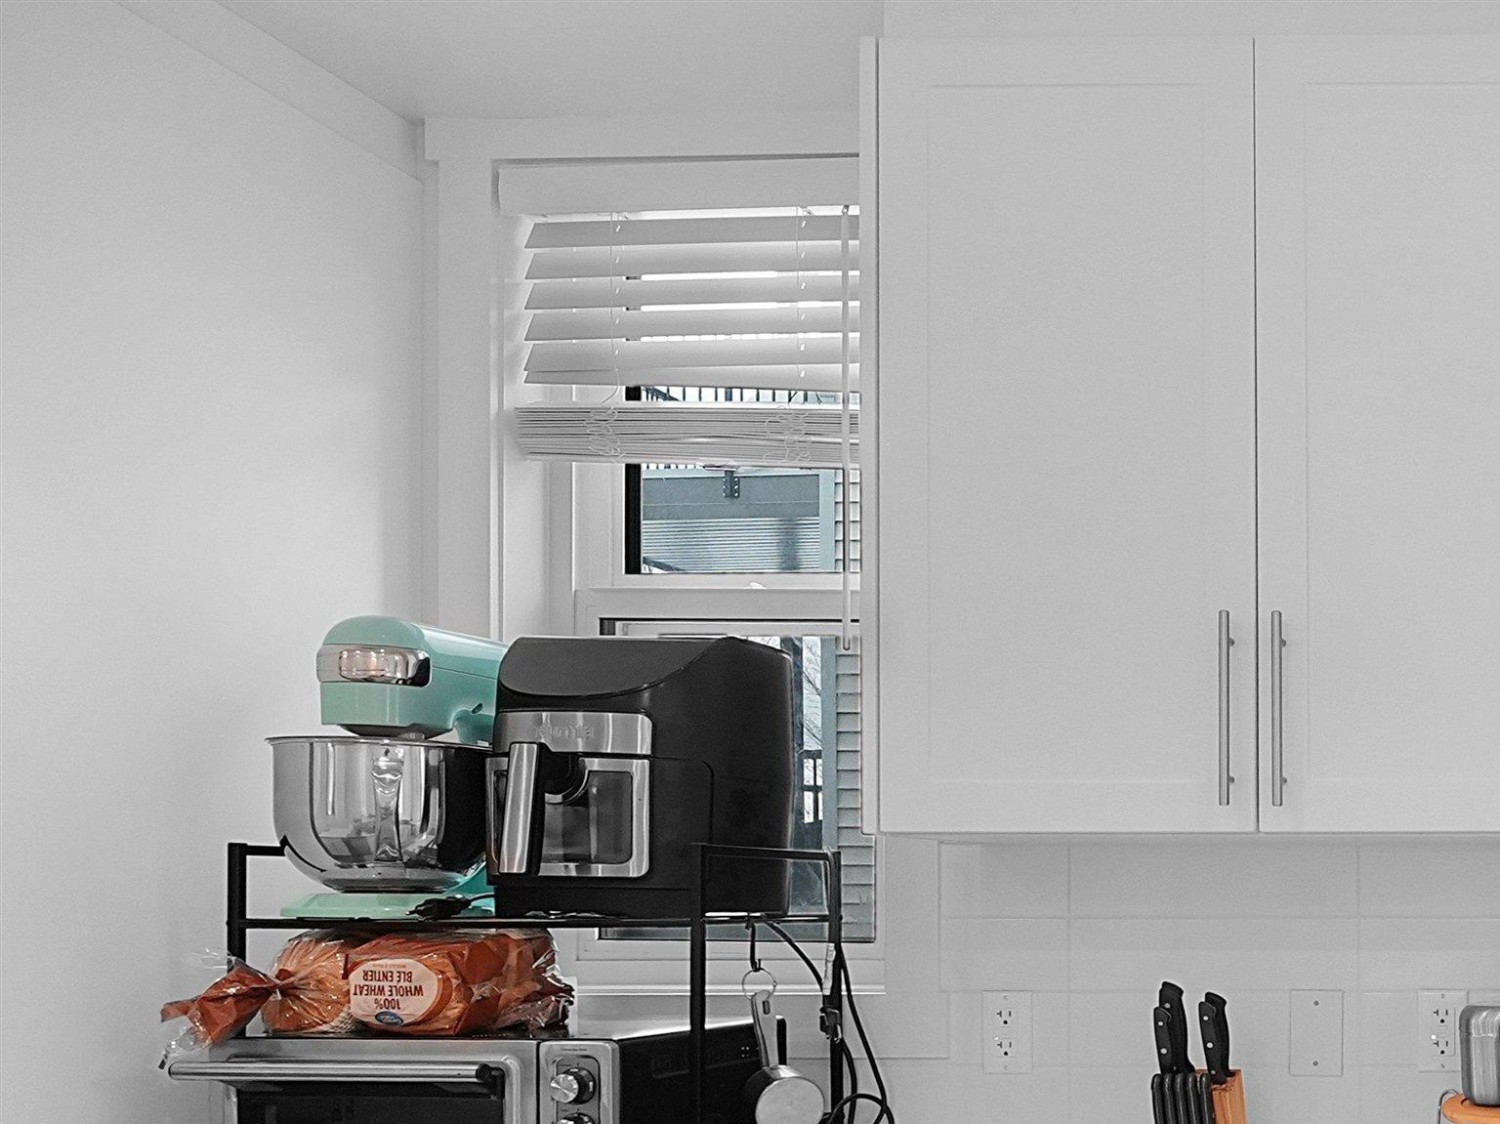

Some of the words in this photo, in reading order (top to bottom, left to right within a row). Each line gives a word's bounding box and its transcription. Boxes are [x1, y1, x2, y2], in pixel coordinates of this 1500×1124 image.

[362, 970, 394, 982] ENTIER
[353, 984, 386, 997] WHEAT
[388, 985, 424, 997] WHOLE
[374, 998, 401, 1010] 100%
